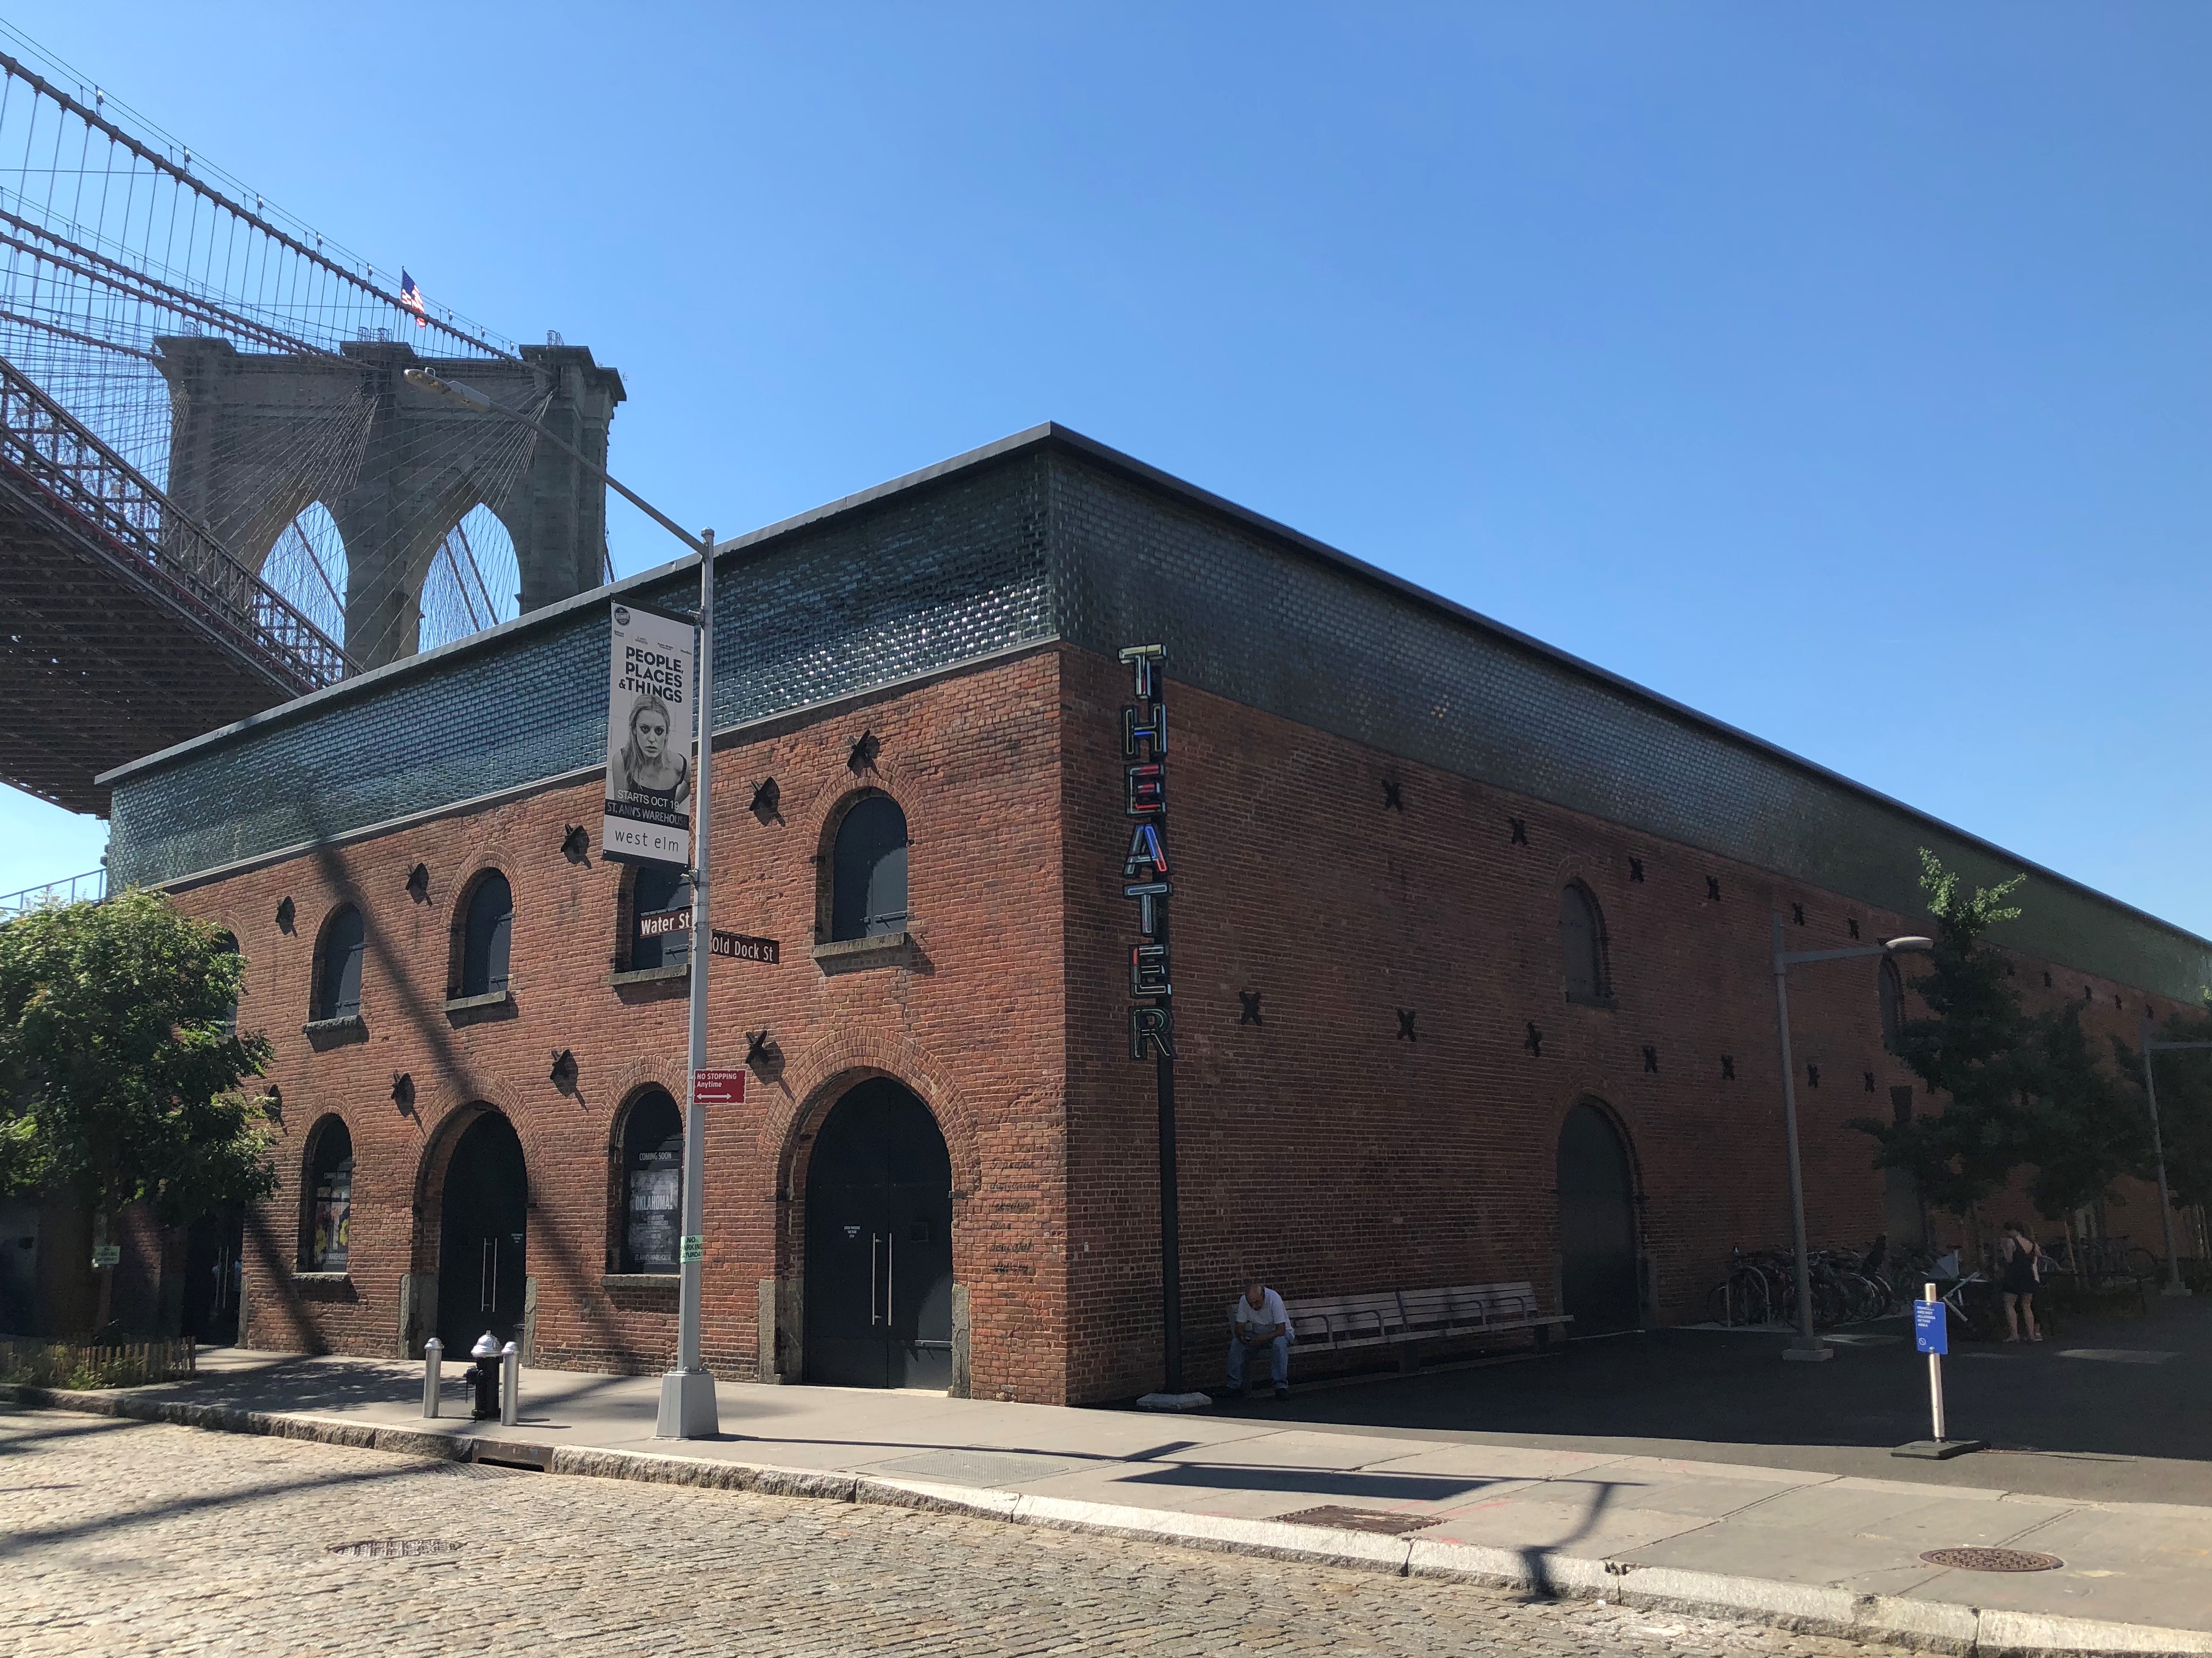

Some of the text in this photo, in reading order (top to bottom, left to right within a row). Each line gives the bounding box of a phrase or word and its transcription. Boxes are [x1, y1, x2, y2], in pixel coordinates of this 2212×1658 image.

[626, 646, 684, 674] PEOPLE,
[626, 661, 682, 688] PLACES
[617, 789, 679, 810] STARTS OCT 19
[607, 802, 688, 827] ST. ANN'S WAREHOUSE
[615, 830, 678, 852] west elm
[1119, 644, 1175, 1059] THEATER
[641, 912, 689, 935] Water St
[712, 936, 773, 962] Old Dock St
[639, 1152, 672, 1161] COMING SOON
[635, 1182, 674, 1210] OKLAHOMA!
